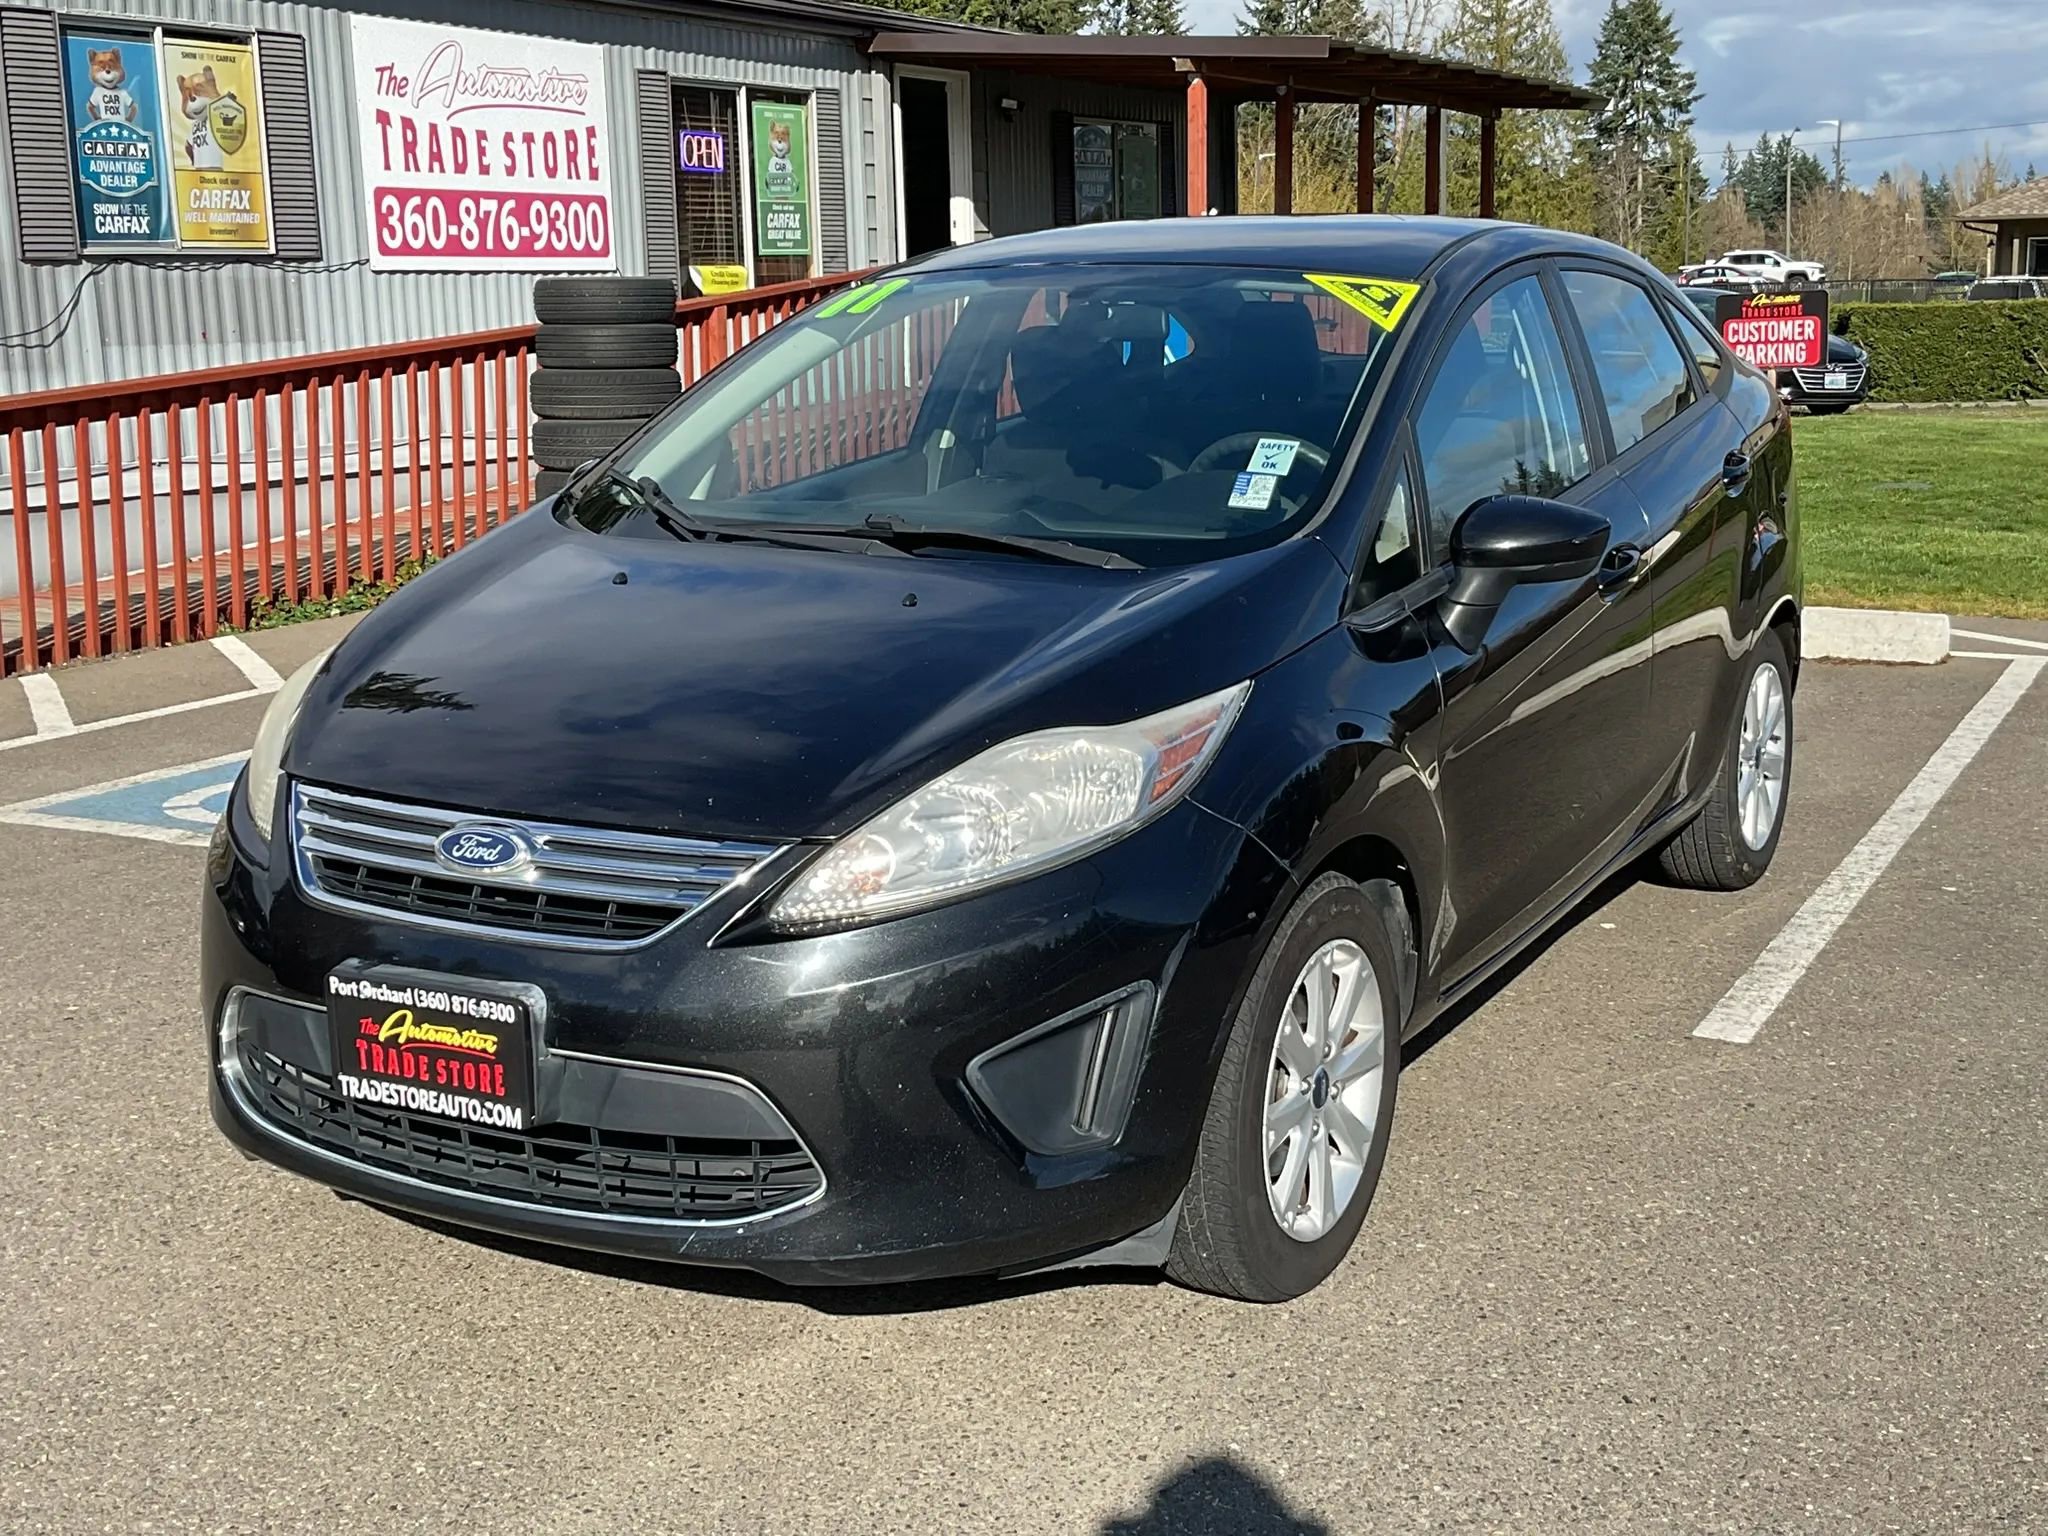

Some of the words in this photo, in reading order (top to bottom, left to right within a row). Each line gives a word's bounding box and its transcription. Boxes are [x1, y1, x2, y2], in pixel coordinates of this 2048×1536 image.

[375, 62, 409, 98] The
[412, 40, 588, 108] Automotive
[102, 94, 120, 104] CAR
[104, 105, 121, 116] FOX
[83, 141, 149, 159] CARFAX
[193, 133, 208, 148] FOX
[376, 108, 490, 176] TRADE
[503, 125, 599, 181] STORE
[684, 134, 722, 169] OPEN
[90, 160, 146, 174] ADVANTAGE
[100, 174, 138, 187] DEALER
[190, 188, 251, 210] CARFAX
[93, 203, 119, 215] SHOW
[120, 204, 133, 215] ME
[134, 204, 148, 216] THE
[184, 211, 207, 223] WELL
[208, 212, 260, 224] MAINTAINED
[95, 215, 150, 234] CARFAX
[381, 194, 603, 251] 360-876-9300
[767, 212, 800, 229] CARFAX
[1742, 306, 1770, 318] TRADE
[1773, 304, 1803, 317] STORE
[1728, 319, 1815, 343] CUSTOMER
[1735, 342, 1806, 364] PARKING
[1259, 442, 1296, 451] SAFETY
[1261, 461, 1278, 469] OK
[452, 834, 504, 861] Ford
[329, 976, 358, 998] Port
[359, 980, 413, 1006] Orchard
[414, 988, 450, 1013] (360)
[451, 994, 515, 1023] 8769300
[360, 1017, 380, 1036] The
[378, 1009, 498, 1054] Automotive
[356, 1039, 429, 1081] TRADE
[436, 1058, 505, 1097] STORE
[338, 1074, 522, 1130] TRADESTOREAUTO.COM
